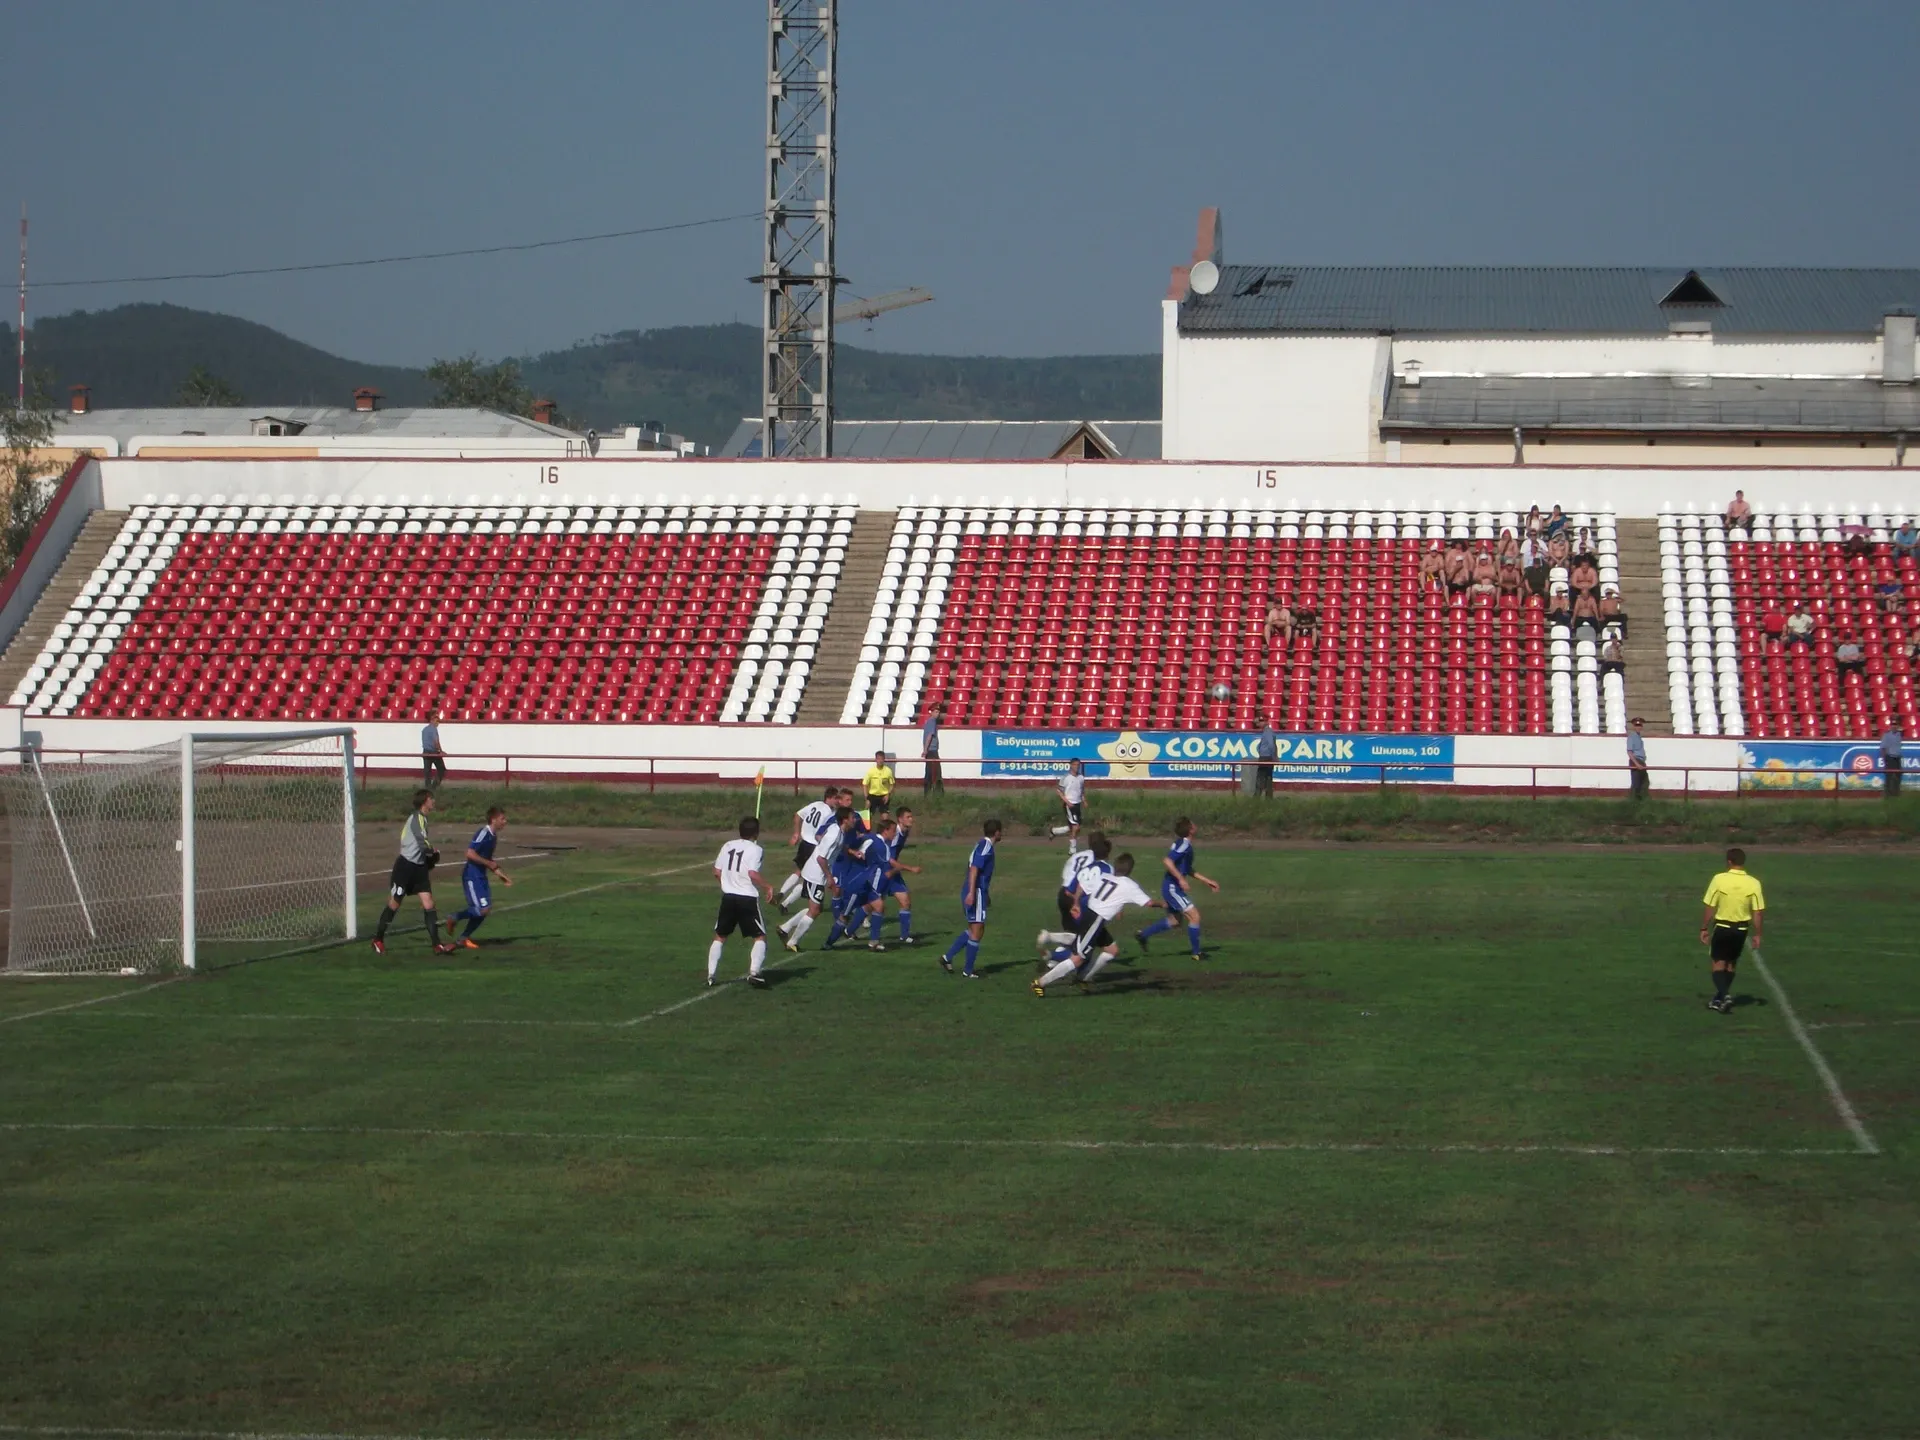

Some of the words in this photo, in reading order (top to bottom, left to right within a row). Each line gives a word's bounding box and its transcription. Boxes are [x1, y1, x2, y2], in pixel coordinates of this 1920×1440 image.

[540, 465, 559, 484] 16
[1256, 469, 1277, 488] 15
[996, 737, 1059, 748] Бабушкина,
[1062, 738, 1080, 747] 104
[1371, 746, 1418, 757] Шилова,
[1421, 747, 1441, 756] 100
[806, 806, 822, 829] 30
[728, 848, 745, 873] 11
